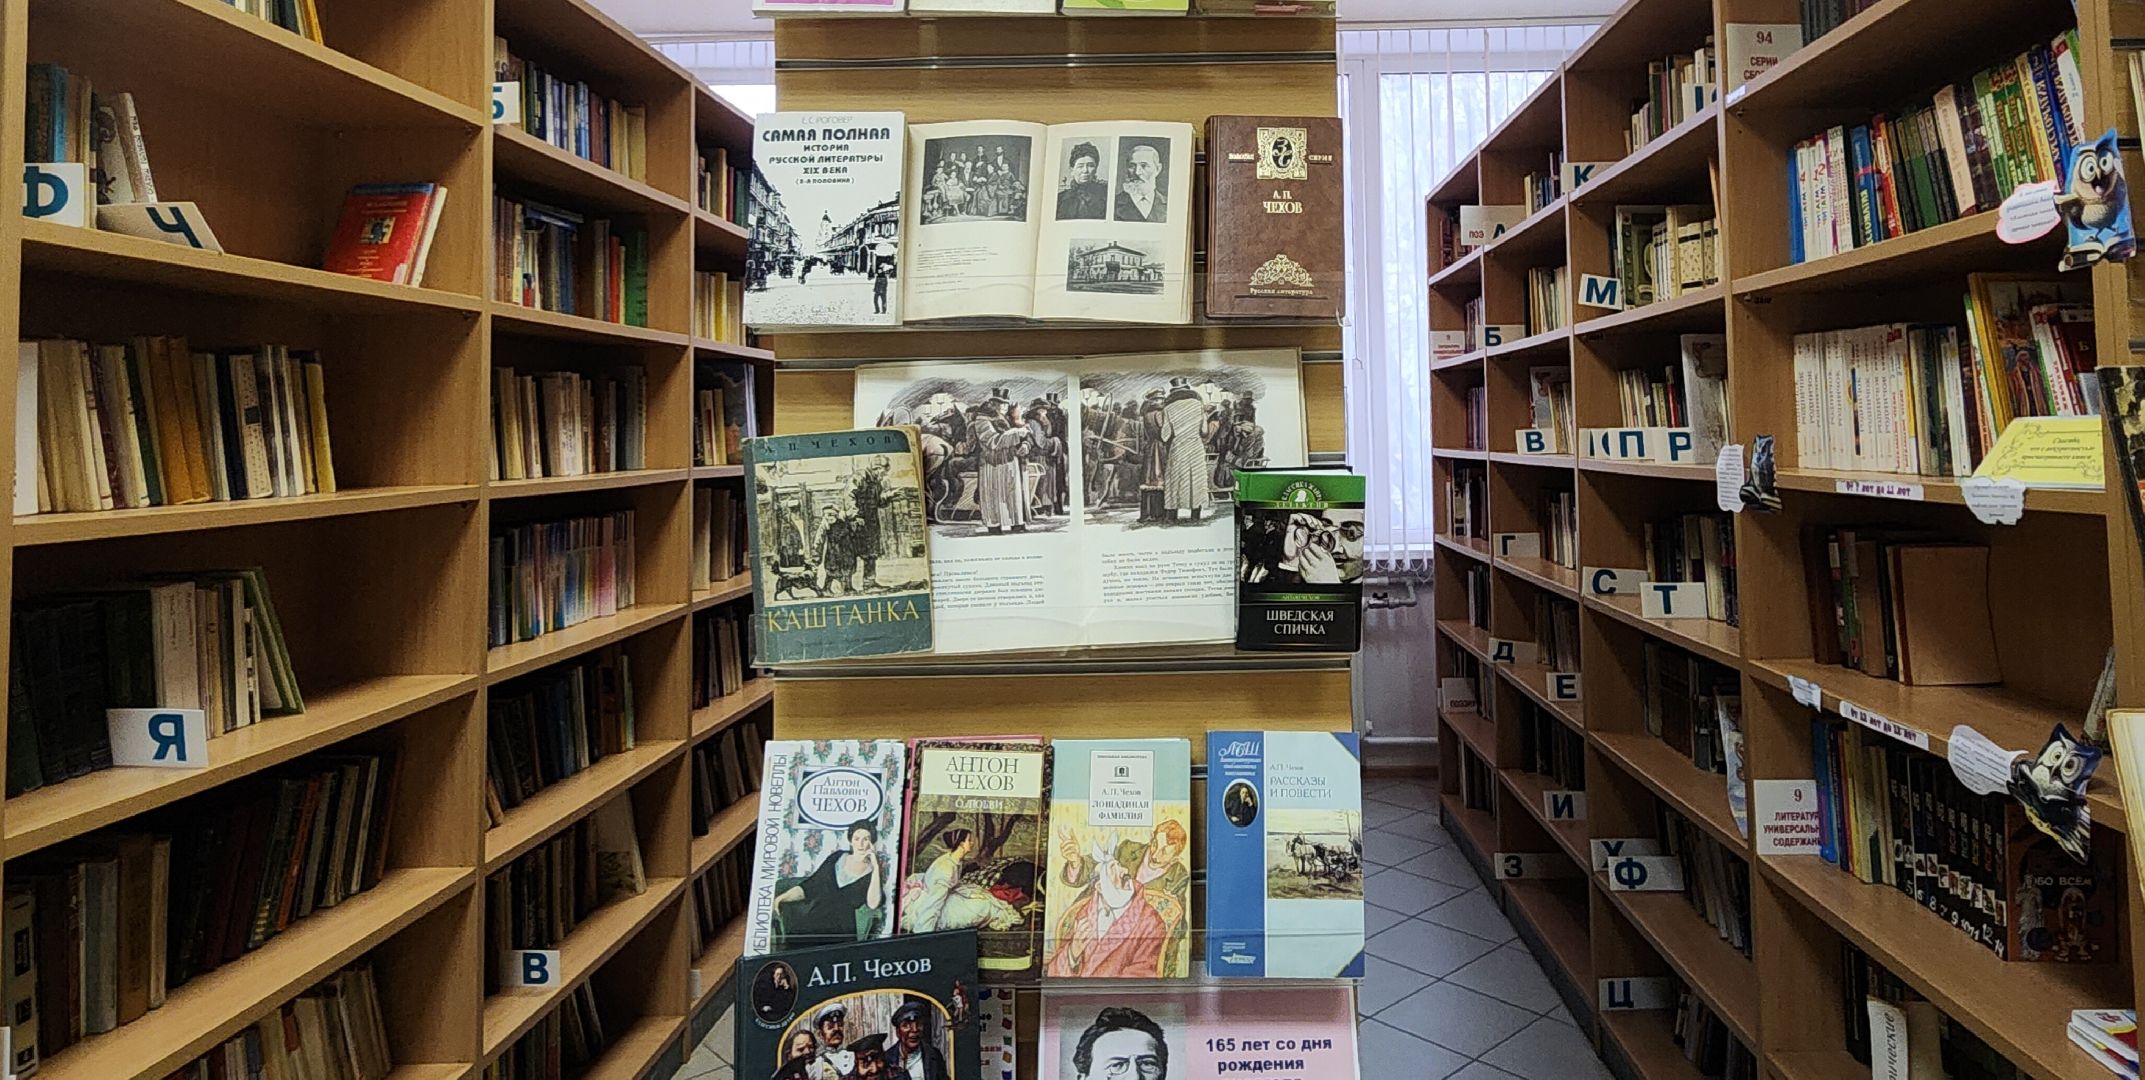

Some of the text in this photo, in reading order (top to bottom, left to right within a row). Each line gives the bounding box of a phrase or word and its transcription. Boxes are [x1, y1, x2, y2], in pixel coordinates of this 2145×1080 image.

[1756, 31, 1773, 44] 94
[763, 128, 890, 142] САМАЯ ПОЛНАЯ
[804, 144, 849, 152] ИСТОРИЯ
[769, 154, 883, 164] РУССКОЙ ЛИТЕРАТУРЫ
[1263, 201, 1303, 214] ЧЕХОВ
[146, 207, 203, 249] Ч
[1585, 277, 1618, 306] М
[1485, 327, 1502, 346] Б
[811, 435, 892, 450] ЧЕХОВ
[1525, 431, 1545, 452] В
[1619, 431, 1645, 457] П
[1668, 431, 1692, 461] Р
[1502, 535, 1516, 555] Г
[1592, 569, 1617, 594] С
[1653, 585, 1677, 615] Т
[768, 600, 920, 633] КАШТАНКА
[1266, 610, 1334, 622] ШВЕДСКАЯ
[1274, 623, 1326, 635] СПИЧКА
[1493, 641, 1515, 664] Д
[1557, 675, 1577, 698] Е
[148, 713, 187, 761] Я
[946, 756, 1019, 773] АНТОН
[824, 776, 860, 787] Антон
[949, 774, 1014, 791] ЧЕХОВ
[1270, 776, 1326, 786] РАССКАЗЫ
[813, 784, 869, 796] Павлович
[1120, 788, 1142, 796] Чехов
[1270, 788, 1331, 799] И ПОВЕСТИ
[1794, 788, 1803, 802] 9
[812, 797, 868, 813] ЧЕХОВ
[1092, 800, 1149, 810] ЛОШАДИНАЯ
[1552, 794, 1574, 819] И
[1098, 811, 1143, 820] ФАМИЛИЯ
[753, 755, 787, 956] ИБЛИОТЕКА МИРОВОЙ НОВЕЛЛЫ
[1504, 855, 1523, 878] З
[1614, 857, 1648, 889] Ф
[2059, 876, 2092, 886] ВСЕМ
[1929, 896, 1937, 912] 8
[1950, 911, 1959, 925] 9
[523, 952, 549, 985] В
[807, 958, 932, 988] А.П. Чехов
[1607, 980, 1634, 1008] Ц
[1206, 1038, 1332, 1052] 165 лет со дня
[1217, 1060, 1304, 1075] рождения
